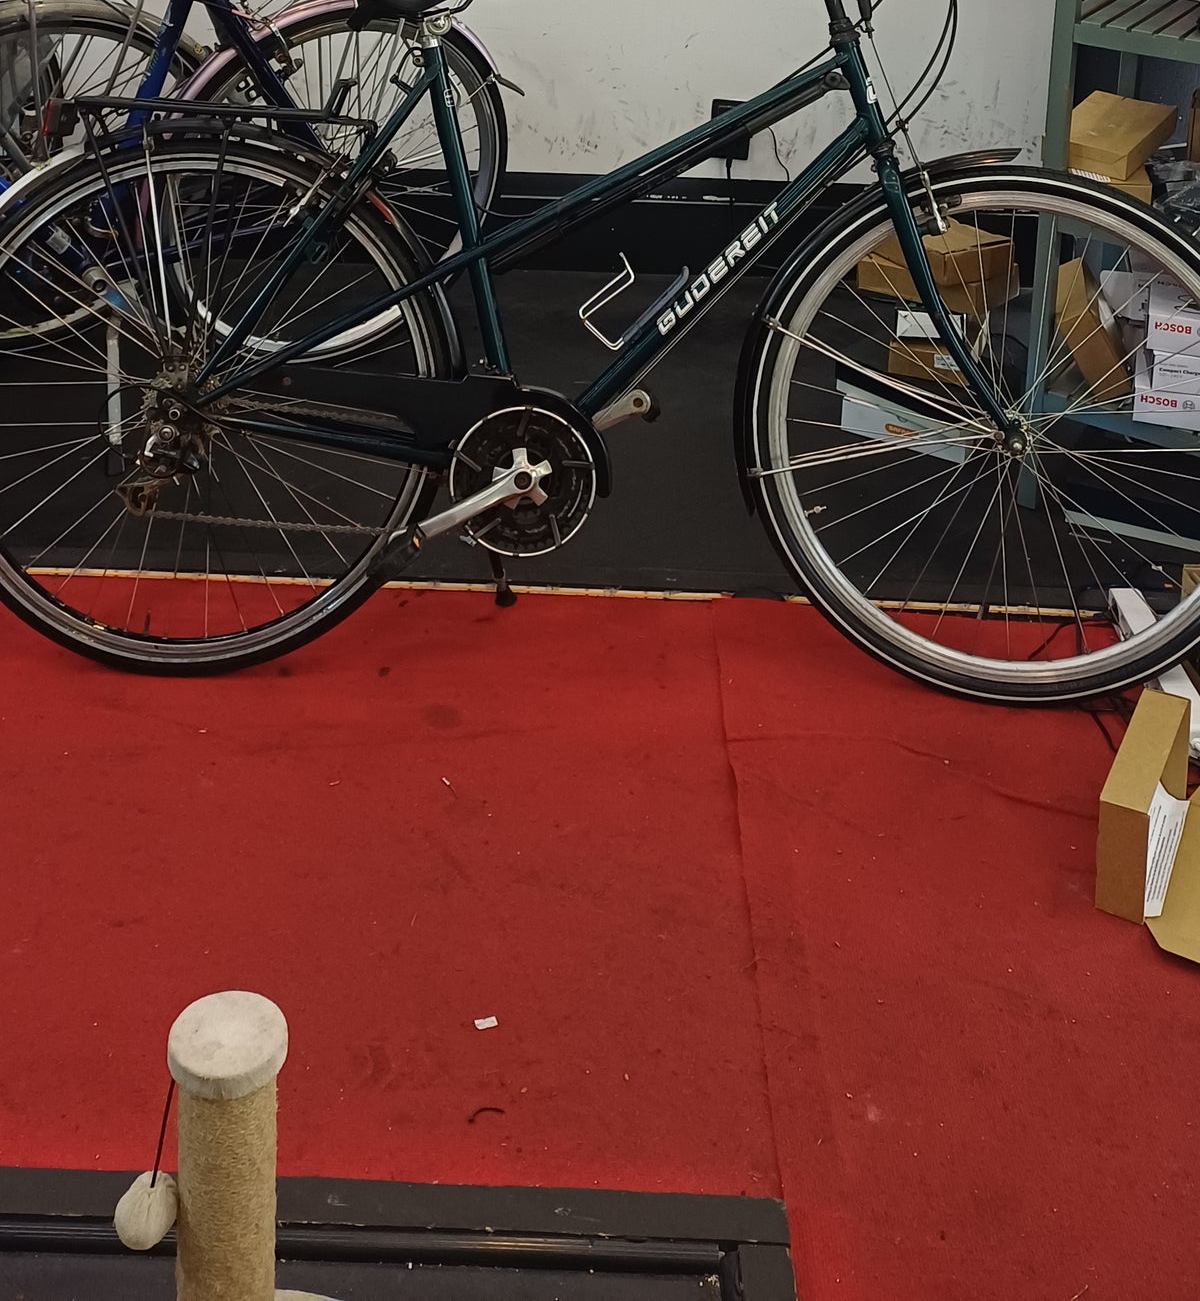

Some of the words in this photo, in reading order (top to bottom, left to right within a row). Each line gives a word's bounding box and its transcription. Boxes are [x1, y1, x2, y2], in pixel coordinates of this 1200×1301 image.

[656, 201, 779, 335] GUDEREIT
[1154, 321, 1192, 335] BOSCH
[1140, 394, 1178, 408] BOSCH
